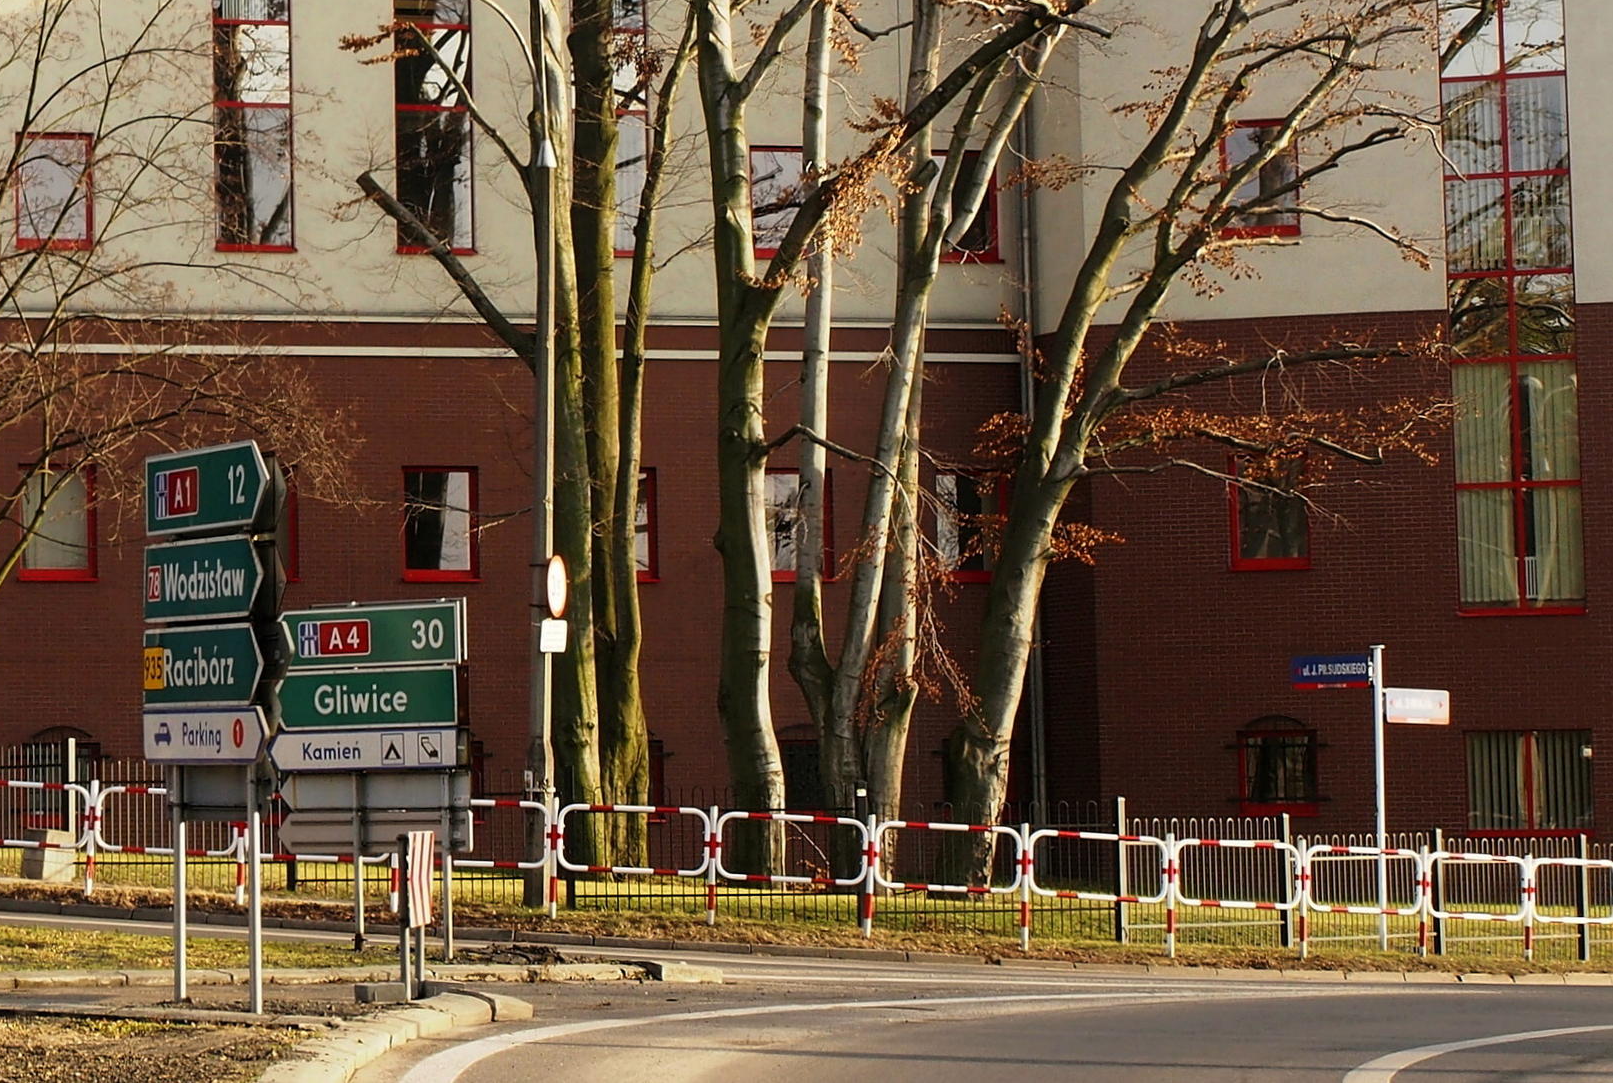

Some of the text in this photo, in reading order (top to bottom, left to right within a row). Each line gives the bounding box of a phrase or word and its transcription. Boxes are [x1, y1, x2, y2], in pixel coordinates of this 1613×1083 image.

[174, 464, 246, 509] A1 12
[148, 558, 245, 602] 78 Wodzisław
[411, 618, 444, 650] 30
[145, 645, 234, 687] 935 Racibórz
[314, 684, 408, 715] Gliwice
[182, 722, 222, 753] Parking
[302, 741, 361, 761] Kamień
